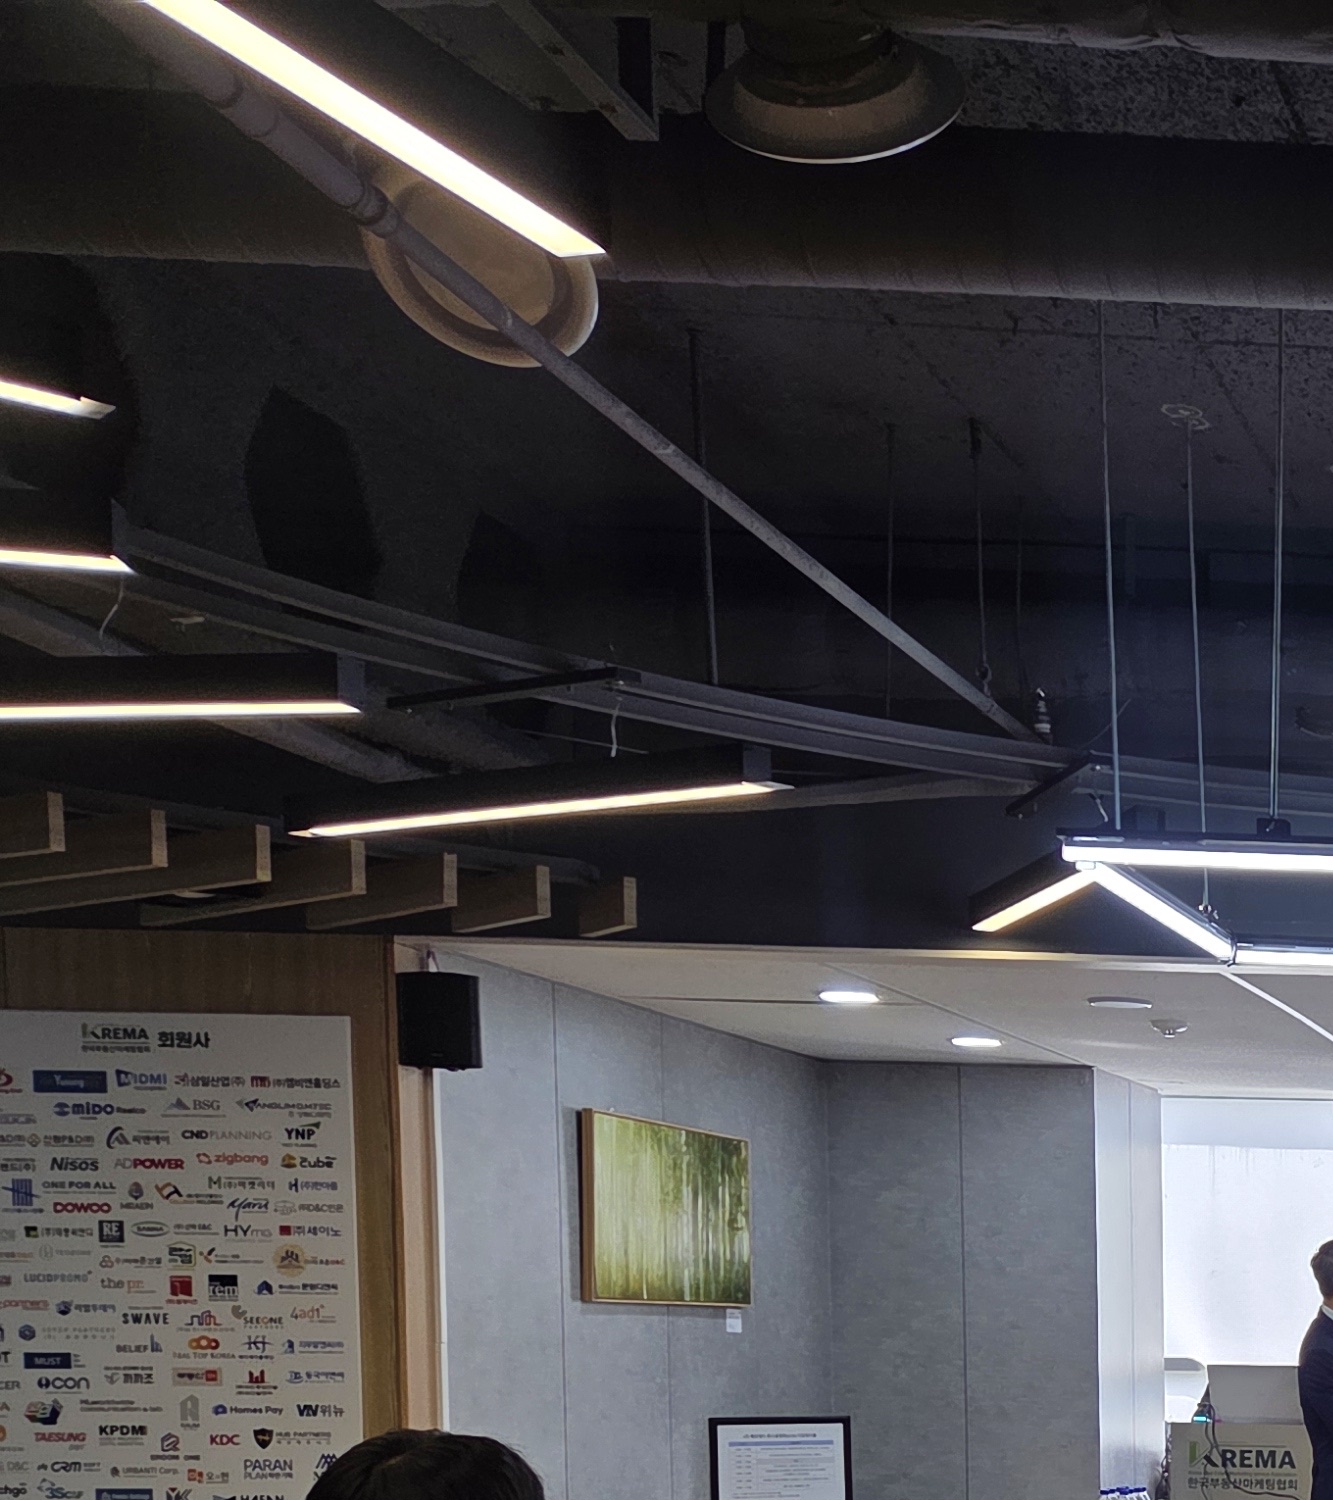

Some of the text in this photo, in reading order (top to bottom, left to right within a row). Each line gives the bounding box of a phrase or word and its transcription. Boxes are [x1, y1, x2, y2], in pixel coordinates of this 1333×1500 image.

[82, 1022, 210, 1048] KREMA 회원사
[193, 1099, 220, 1110] BSG
[285, 1128, 315, 1140] YNP
[214, 1152, 269, 1166] zigbang
[93, 1181, 116, 1189] ALL
[53, 1202, 112, 1214] DOWOO
[122, 1313, 169, 1325] SWAVE
[210, 1434, 240, 1446] KDC
[1189, 1441, 1296, 1469] KREMA
[244, 1459, 293, 1471] PARAN
[1188, 1477, 1298, 1491] 한국부동산마케팅협회
